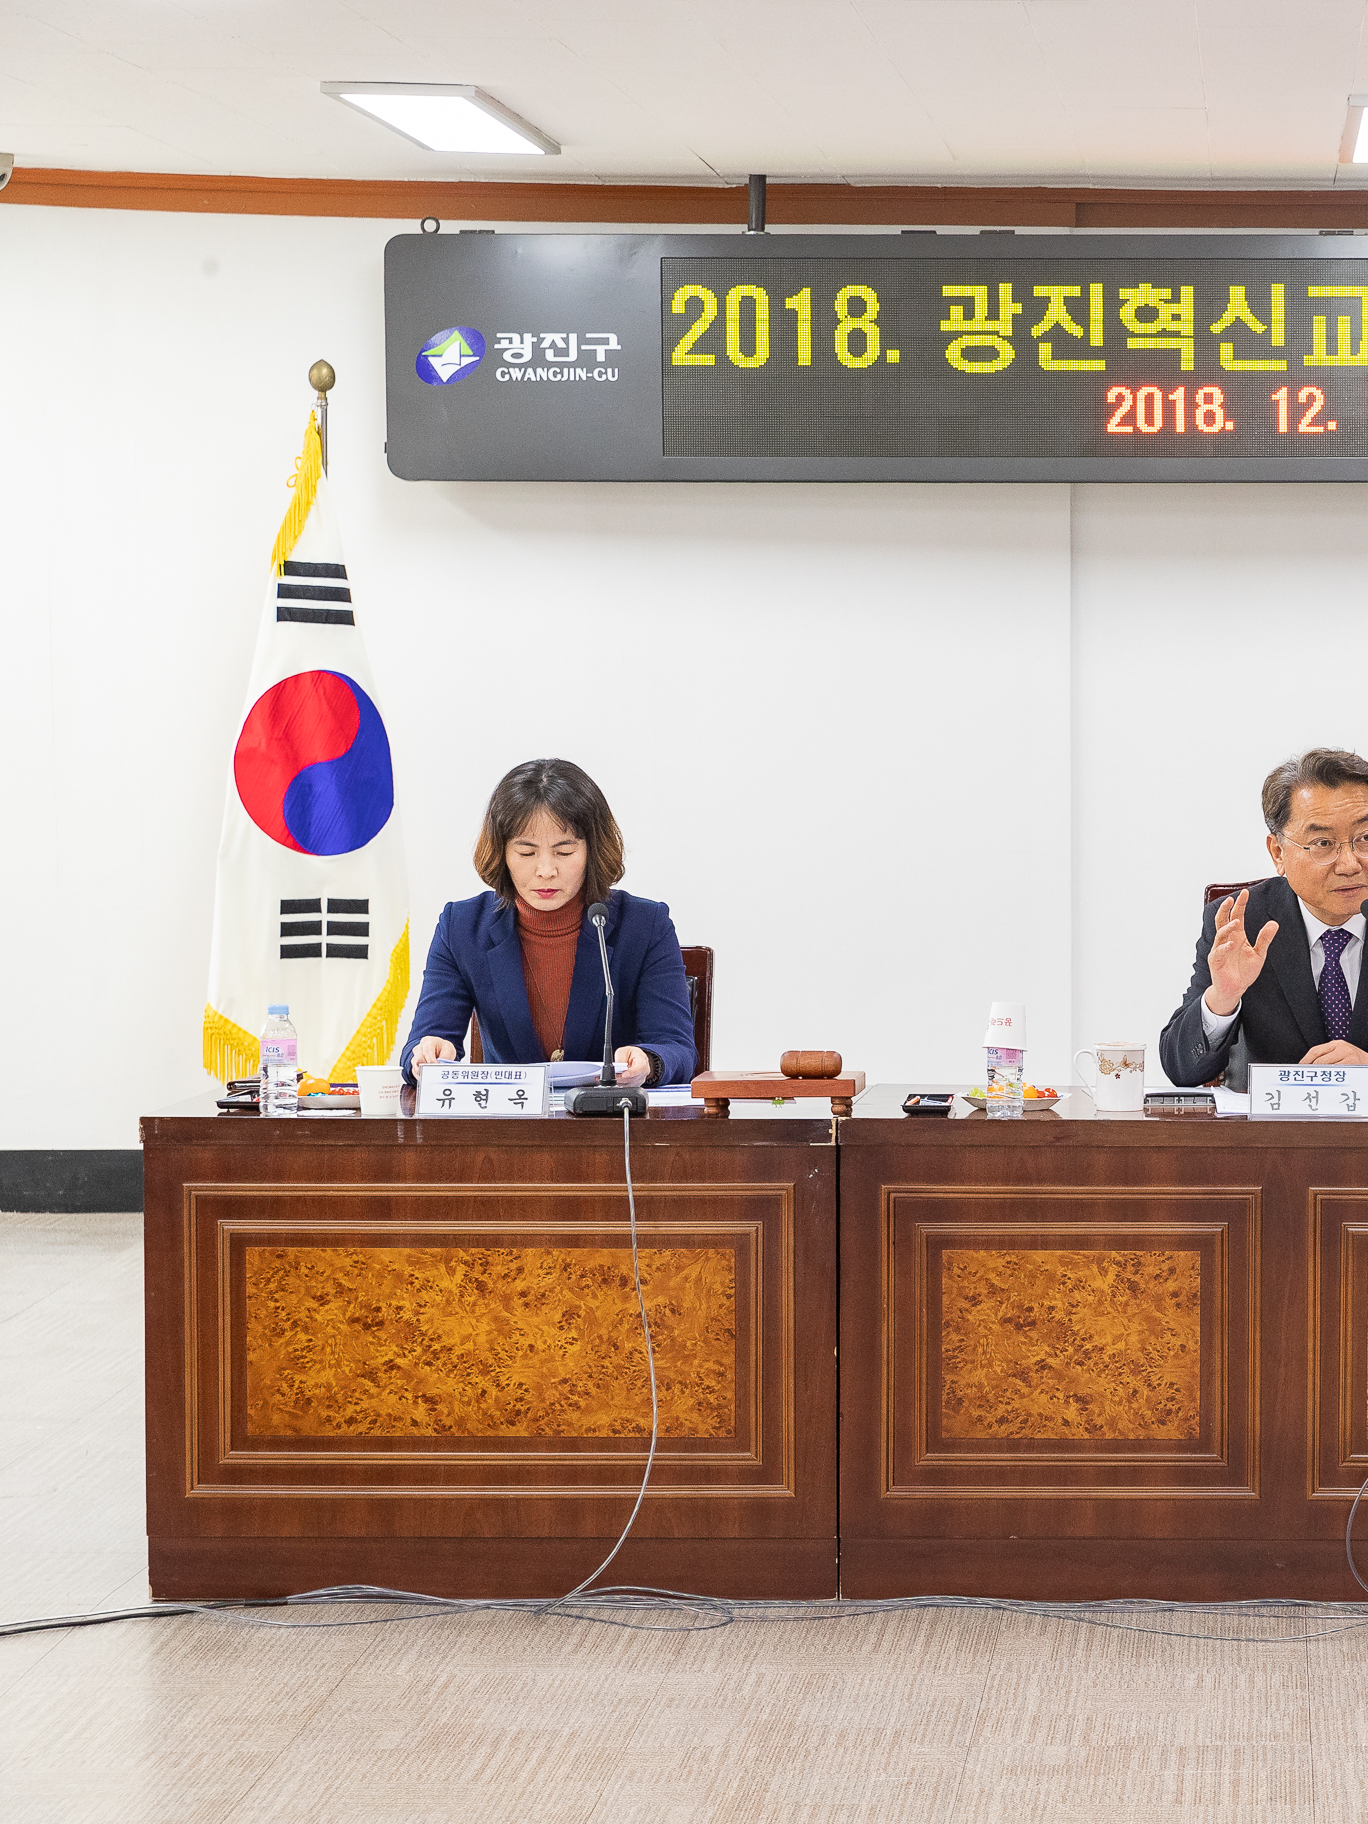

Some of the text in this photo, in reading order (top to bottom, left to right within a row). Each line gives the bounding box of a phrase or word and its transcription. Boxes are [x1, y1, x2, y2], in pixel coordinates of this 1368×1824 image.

[670, 283, 901, 369] 2018.
[493, 332, 622, 364] 광진구
[495, 367, 619, 382] GWANGJIN-GU
[1105, 385, 1236, 434] 2018.
[1271, 385, 1338, 434] 12.
